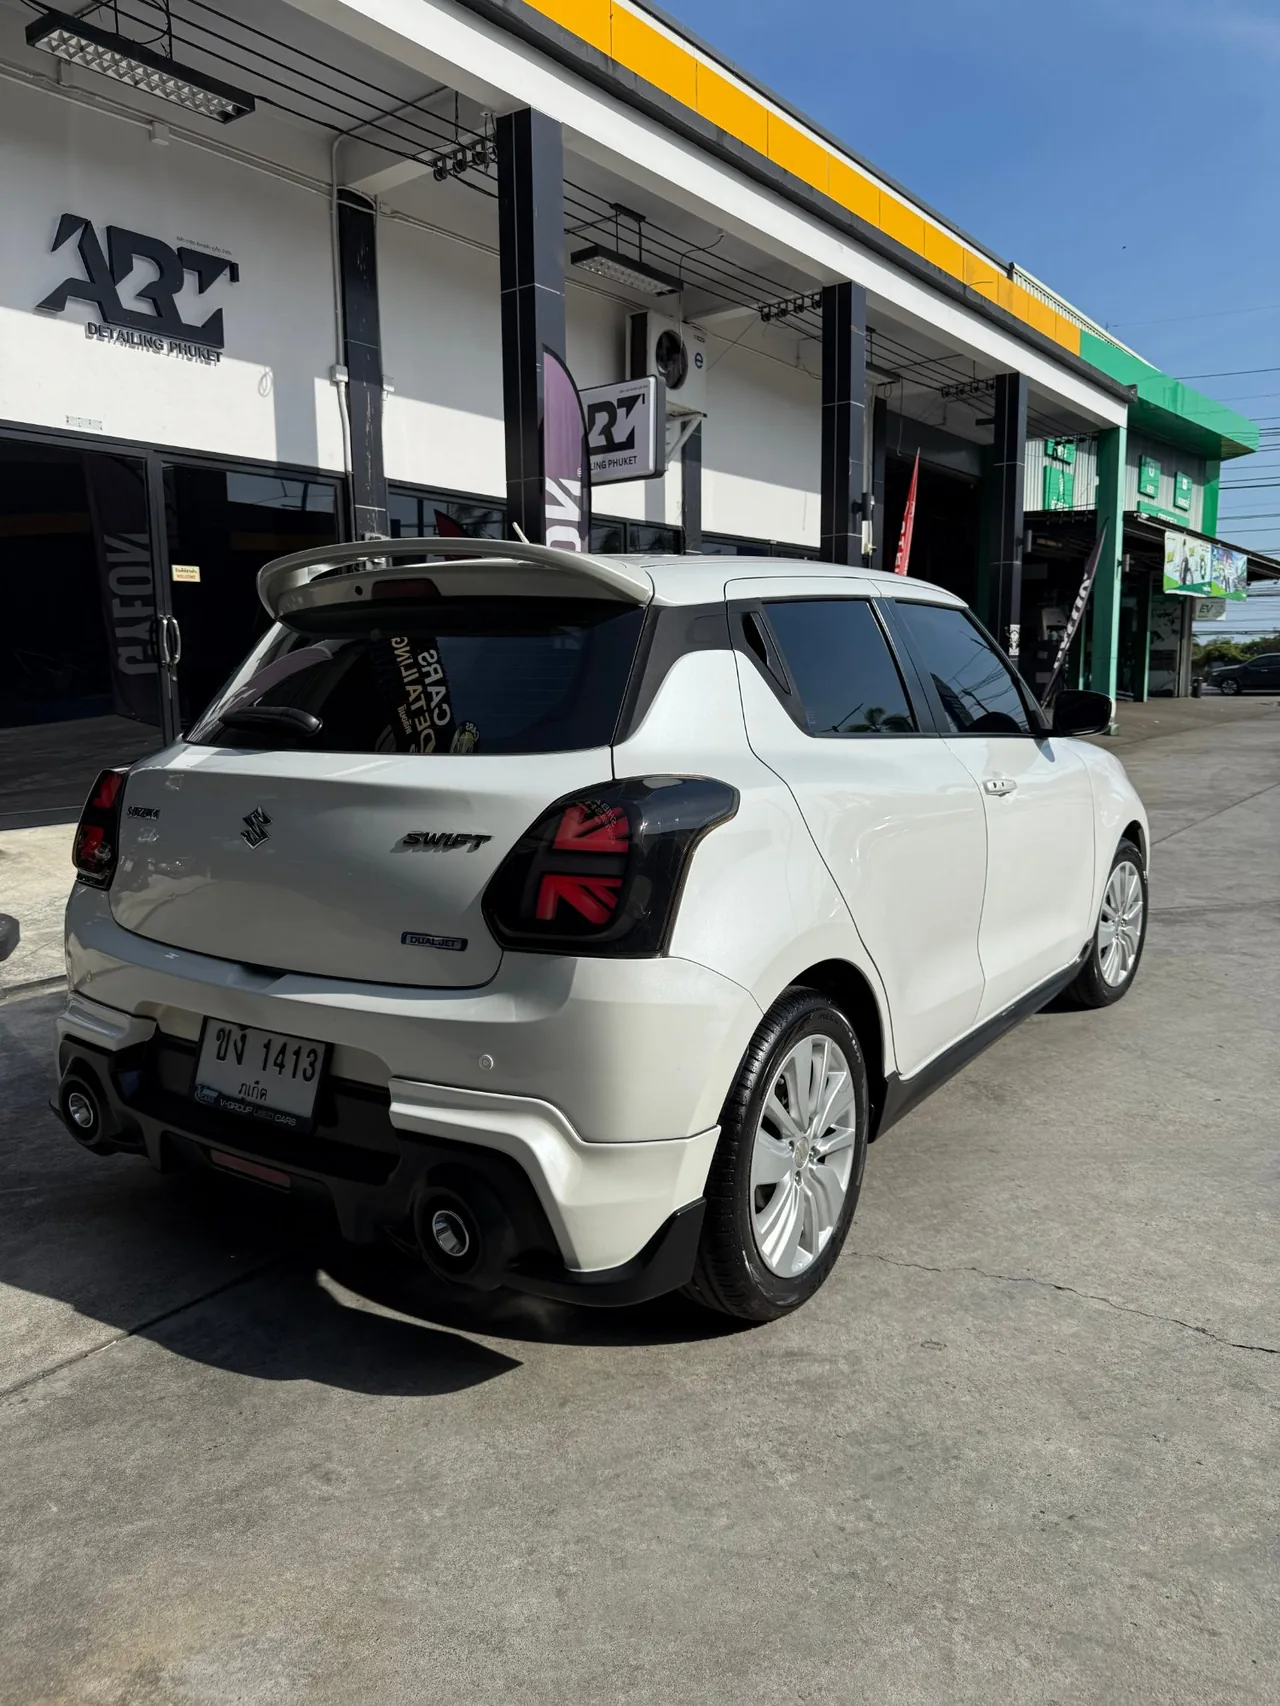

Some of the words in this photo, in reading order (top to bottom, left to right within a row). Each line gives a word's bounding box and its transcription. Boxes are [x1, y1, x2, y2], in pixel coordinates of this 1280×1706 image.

[87, 321, 164, 350] DETAILING
[168, 341, 222, 362] PHUKET
[586, 393, 646, 456] RT
[590, 457, 607, 472] LING
[607, 455, 638, 470] PHUKET
[402, 831, 493, 850] SWIFT
[262, 1038, 318, 1082] 1413
[238, 1080, 268, 1101] ภูเก็ต
[220, 1098, 253, 1114] V-GROUP
[274, 1113, 297, 1127] CARS
